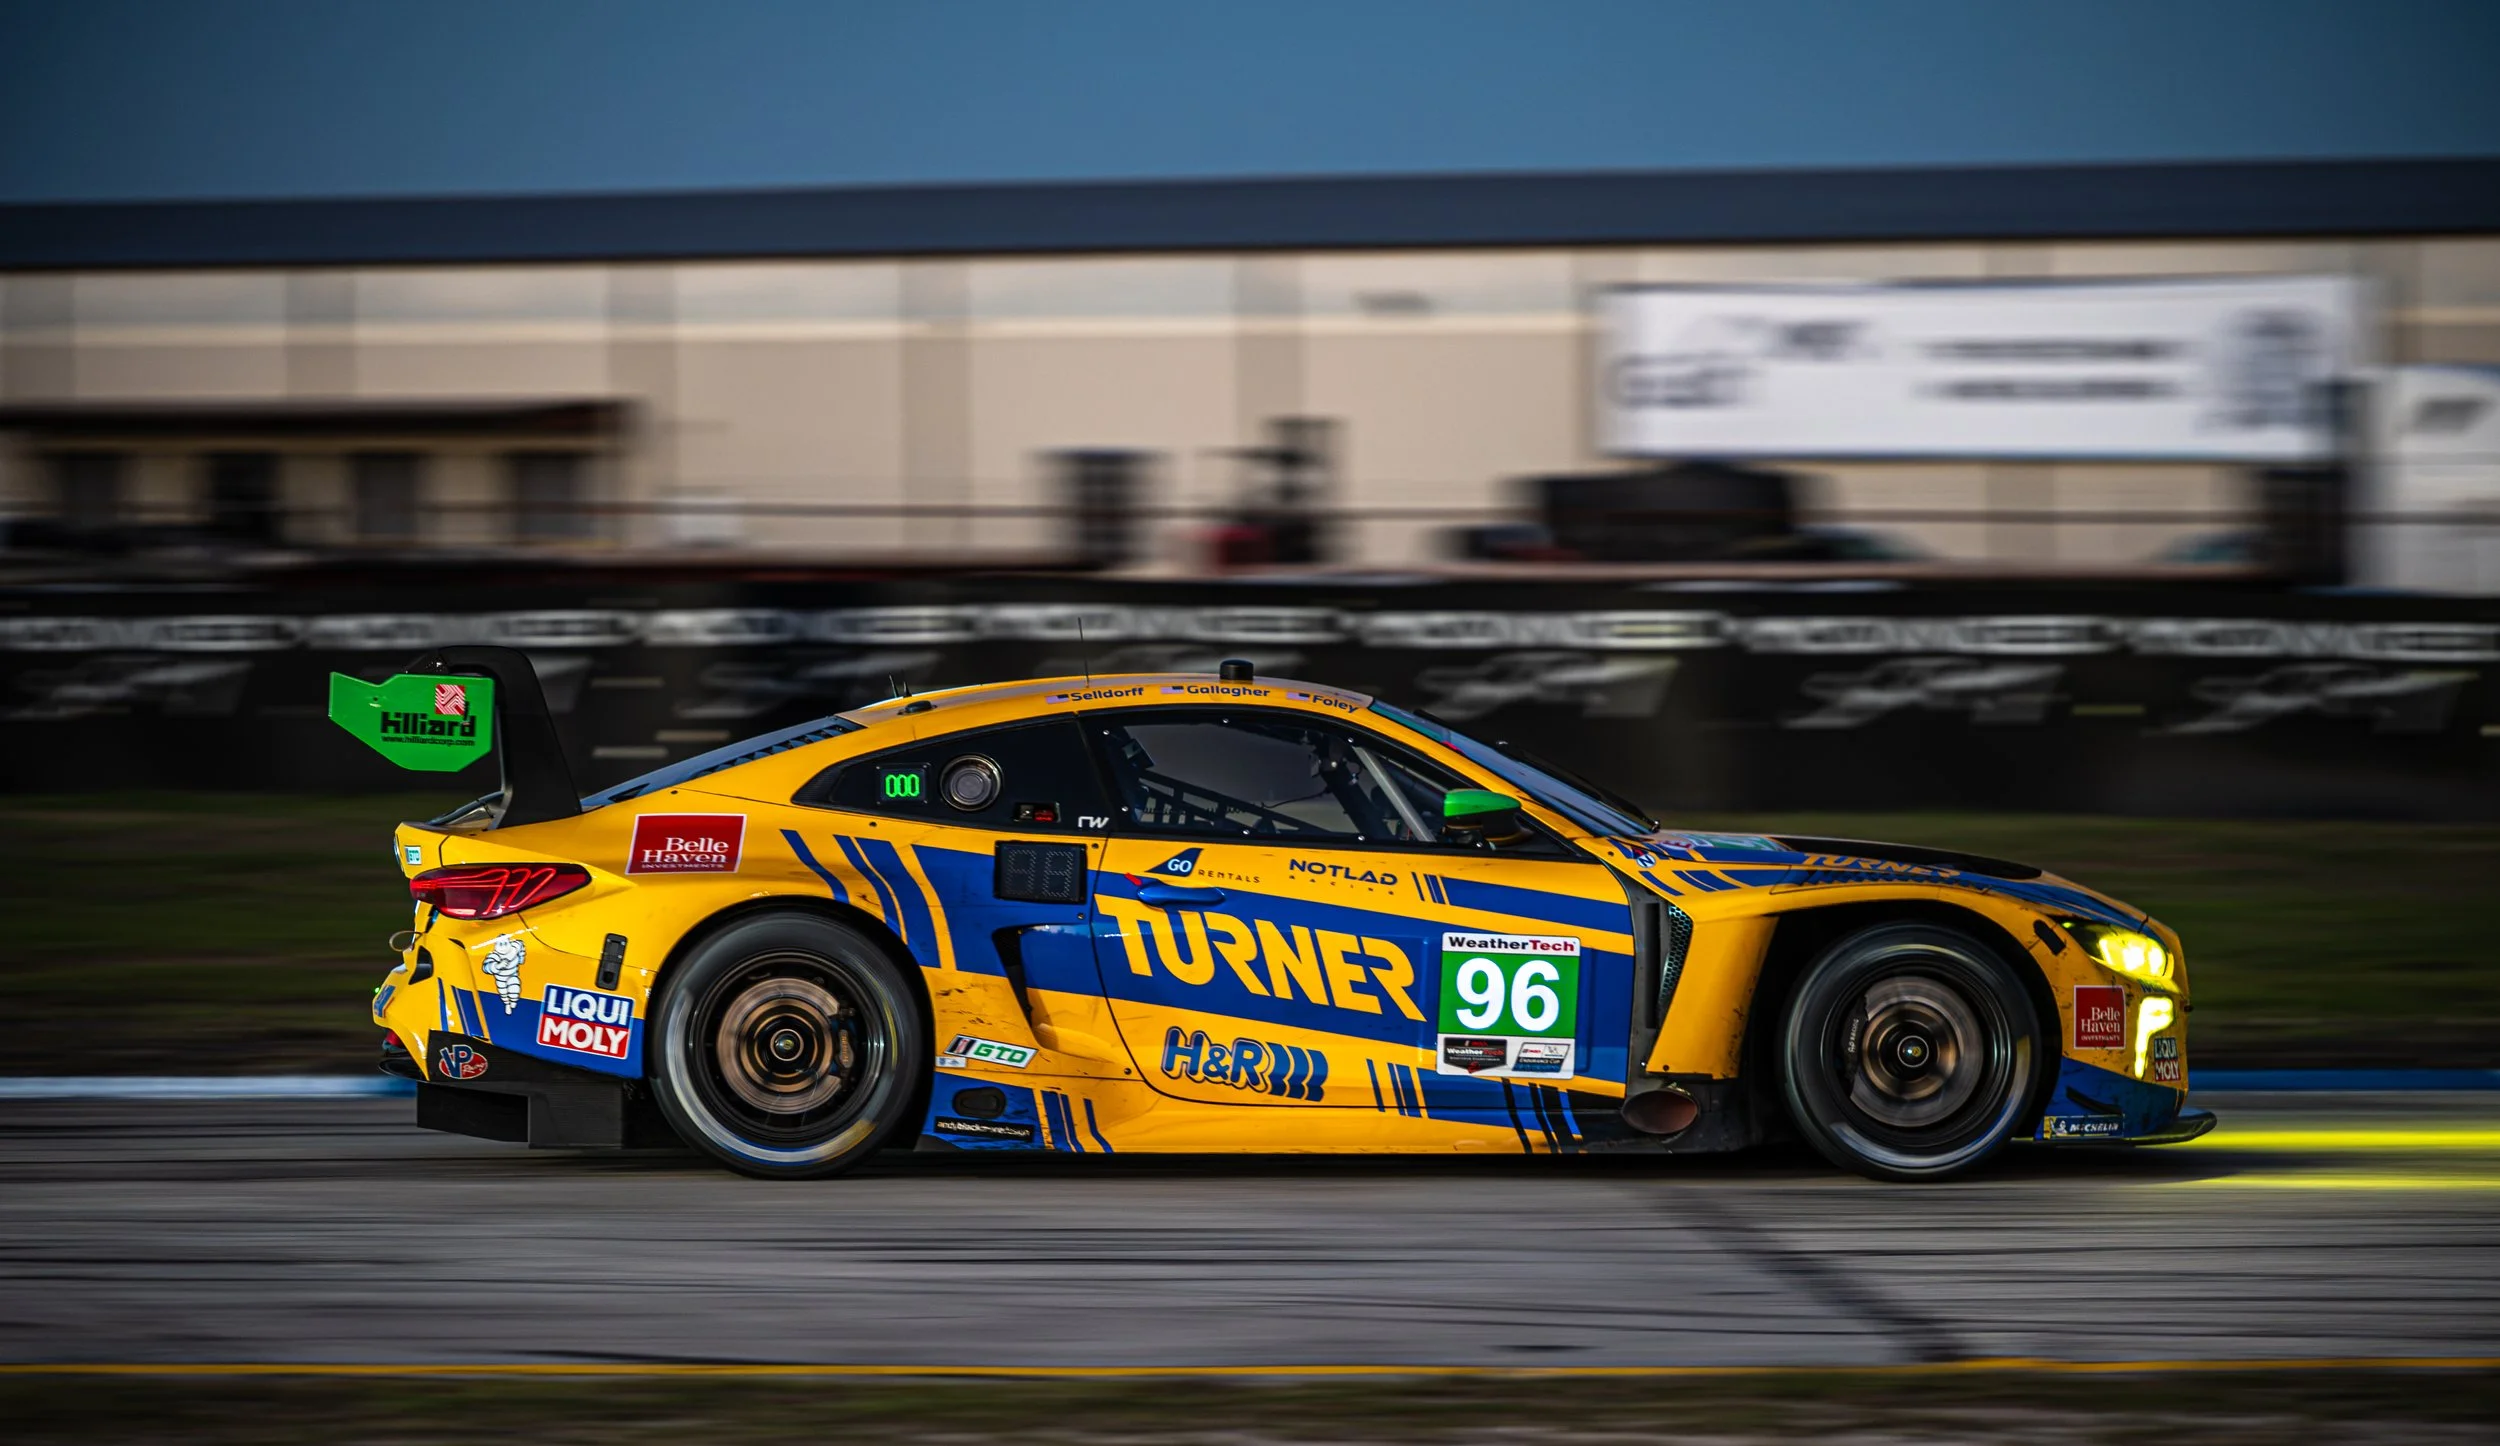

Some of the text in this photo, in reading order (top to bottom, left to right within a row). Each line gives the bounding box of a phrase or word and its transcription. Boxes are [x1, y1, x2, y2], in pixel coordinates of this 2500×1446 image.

[1070, 687, 1144, 701] Selldorff
[1187, 685, 1271, 698] Gallagher
[1312, 695, 1359, 713] Foley
[665, 837, 729, 853] Belle
[641, 850, 727, 863] Haven
[1167, 858, 1261, 884] GO RENTALS
[1289, 858, 1398, 886] NOTLAD
[1448, 936, 1575, 952] WeatherTech
[1094, 894, 1427, 1022] TURNER
[1456, 958, 1560, 1031] 96
[547, 988, 630, 1026] LIQUI
[2091, 1007, 2121, 1022] Belle
[542, 1017, 629, 1054] MOLY
[2081, 1019, 2121, 1034] Haven
[973, 1043, 1028, 1063] GTD
[1161, 1026, 1270, 1092] H&R
[2154, 1039, 2178, 1059] LIQUI
[440, 1045, 473, 1078] VP
[2155, 1060, 2179, 1080] MOLY
